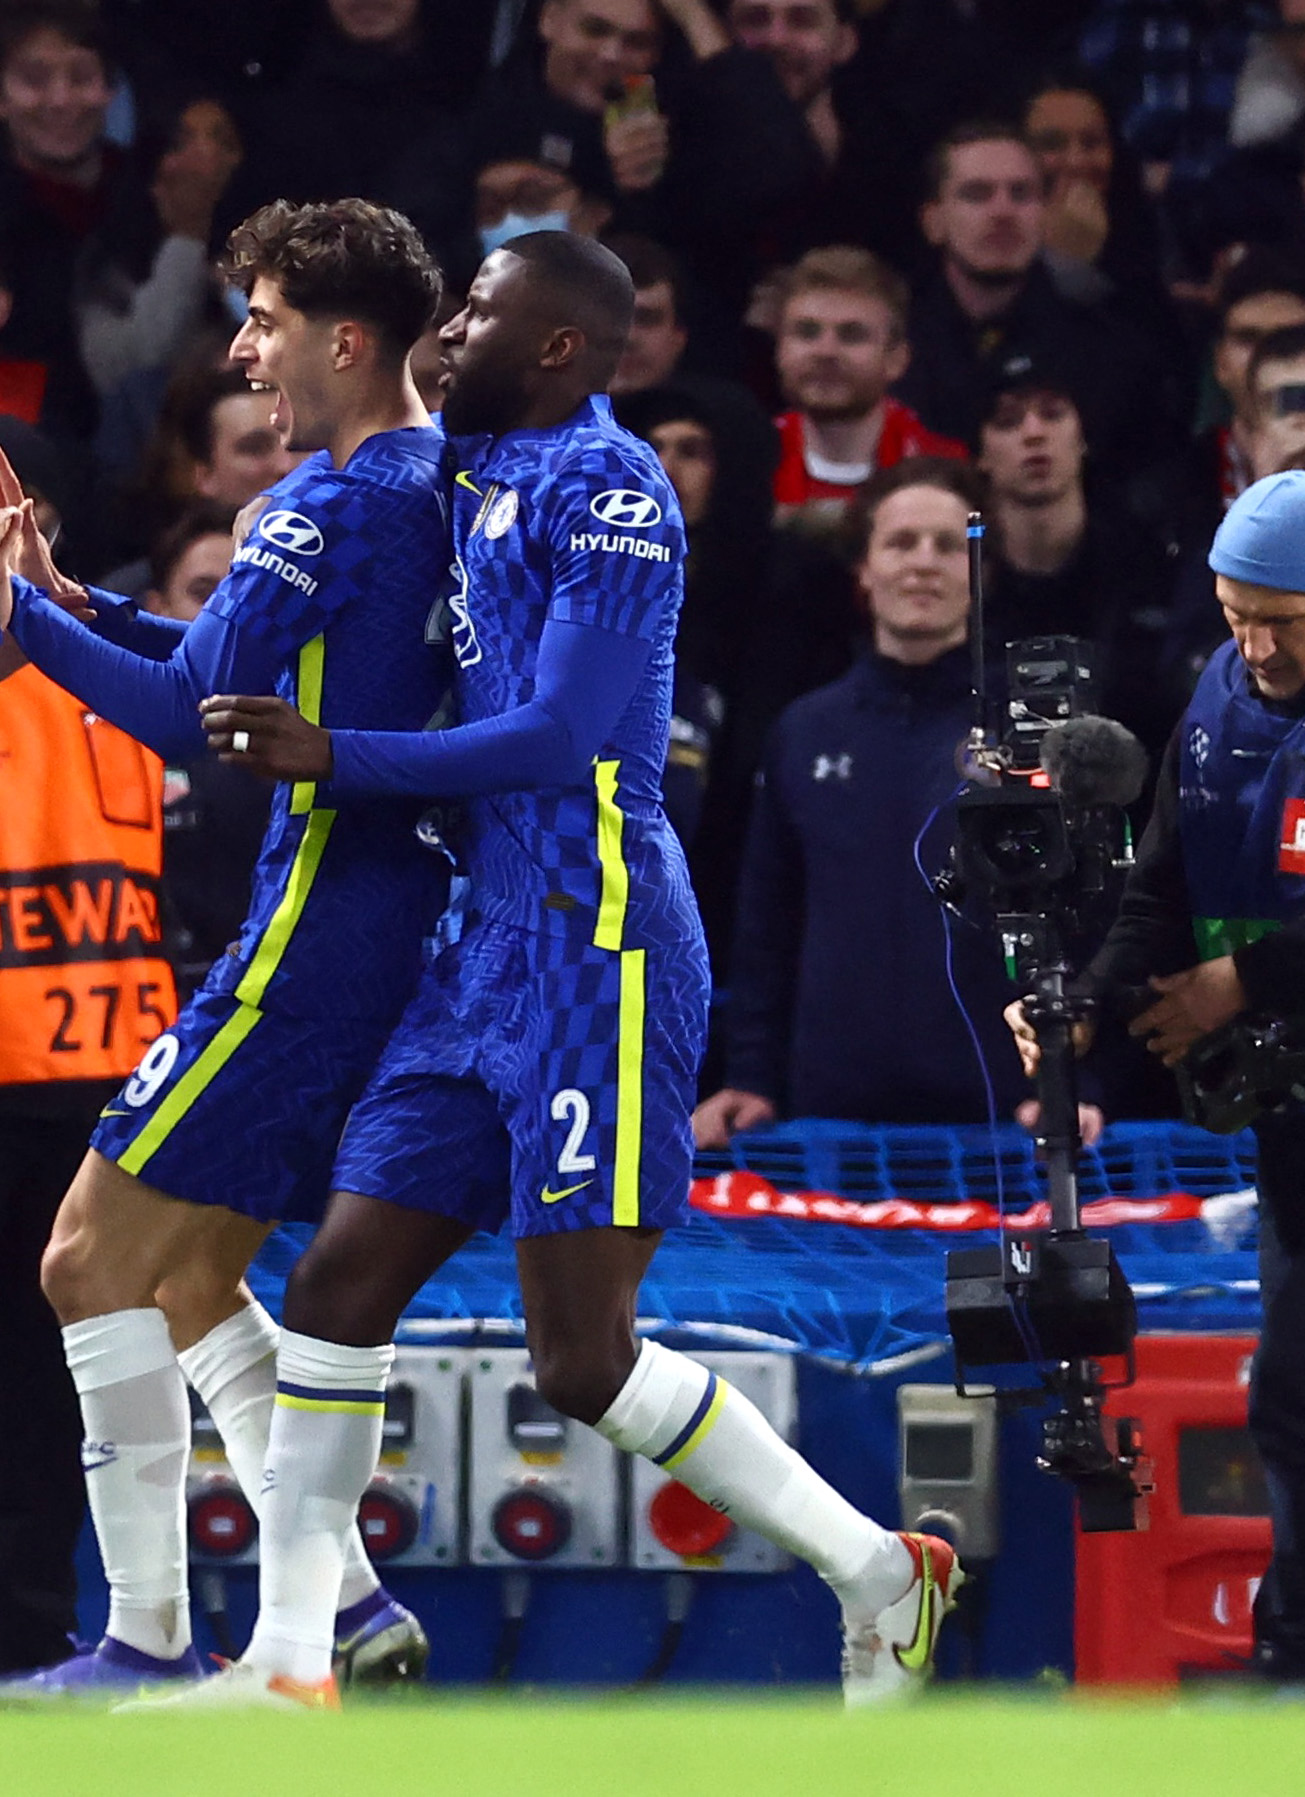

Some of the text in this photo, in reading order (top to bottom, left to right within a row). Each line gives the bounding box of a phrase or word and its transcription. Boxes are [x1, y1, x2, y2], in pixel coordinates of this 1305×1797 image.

[570, 533, 671, 563] HYUNDAI
[45, 983, 168, 1053] 275
[123, 1033, 180, 1108] 9
[550, 1088, 596, 1174] 2
